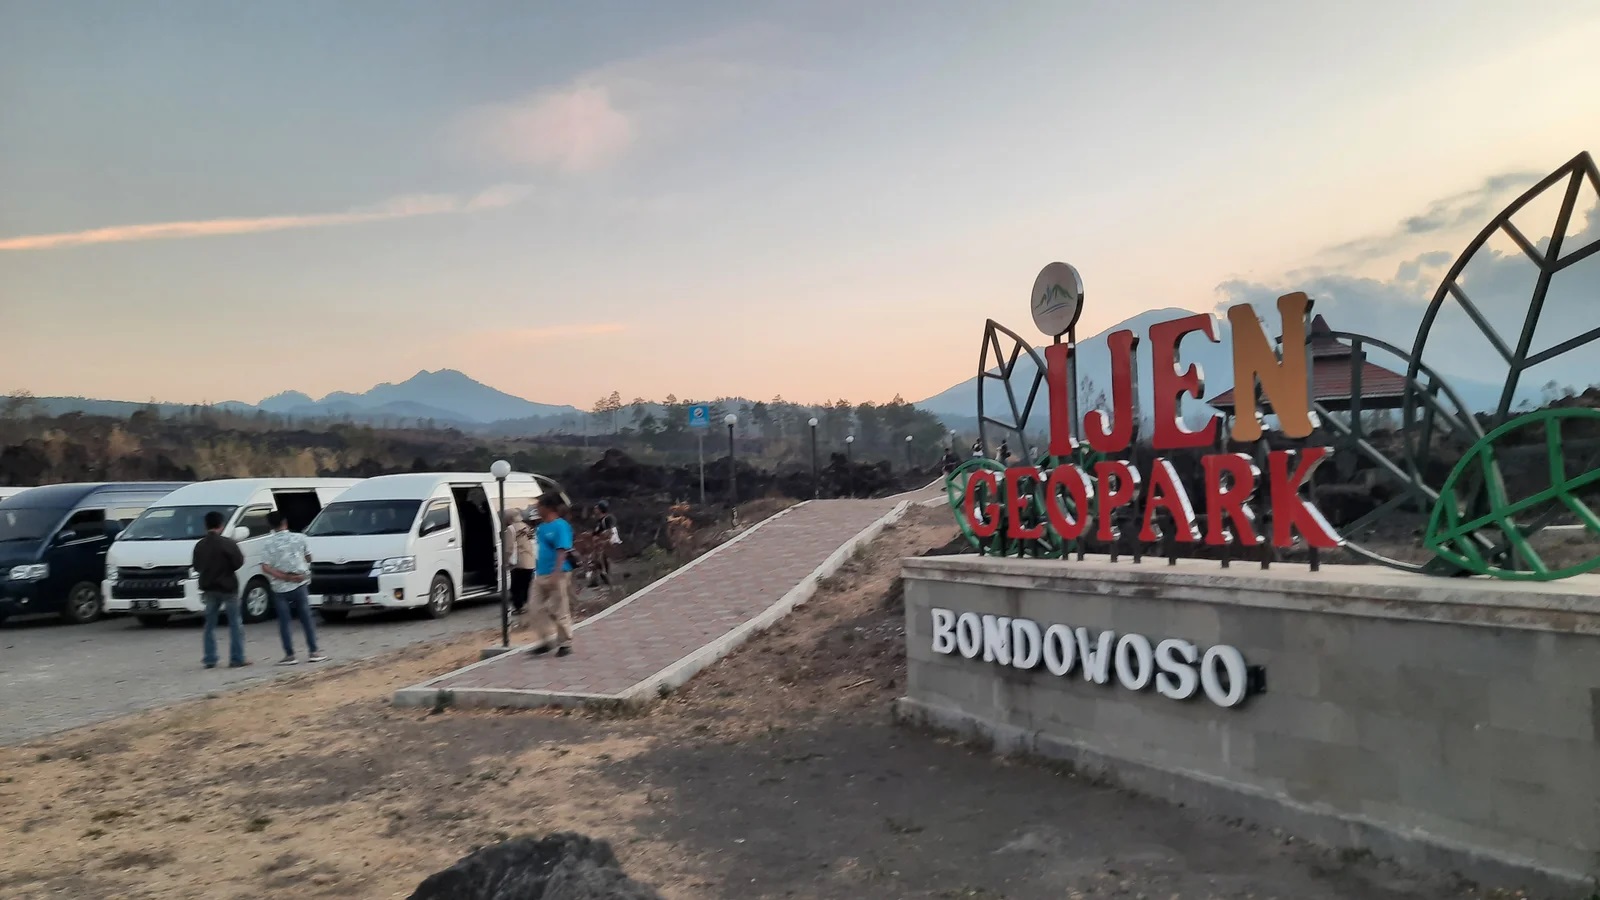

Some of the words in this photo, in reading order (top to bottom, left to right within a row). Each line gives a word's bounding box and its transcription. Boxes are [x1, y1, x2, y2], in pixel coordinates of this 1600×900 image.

[1045, 291, 1316, 456] IJEN
[965, 447, 1345, 548] GEOPARK
[931, 608, 1247, 707] BONDOWOSO
